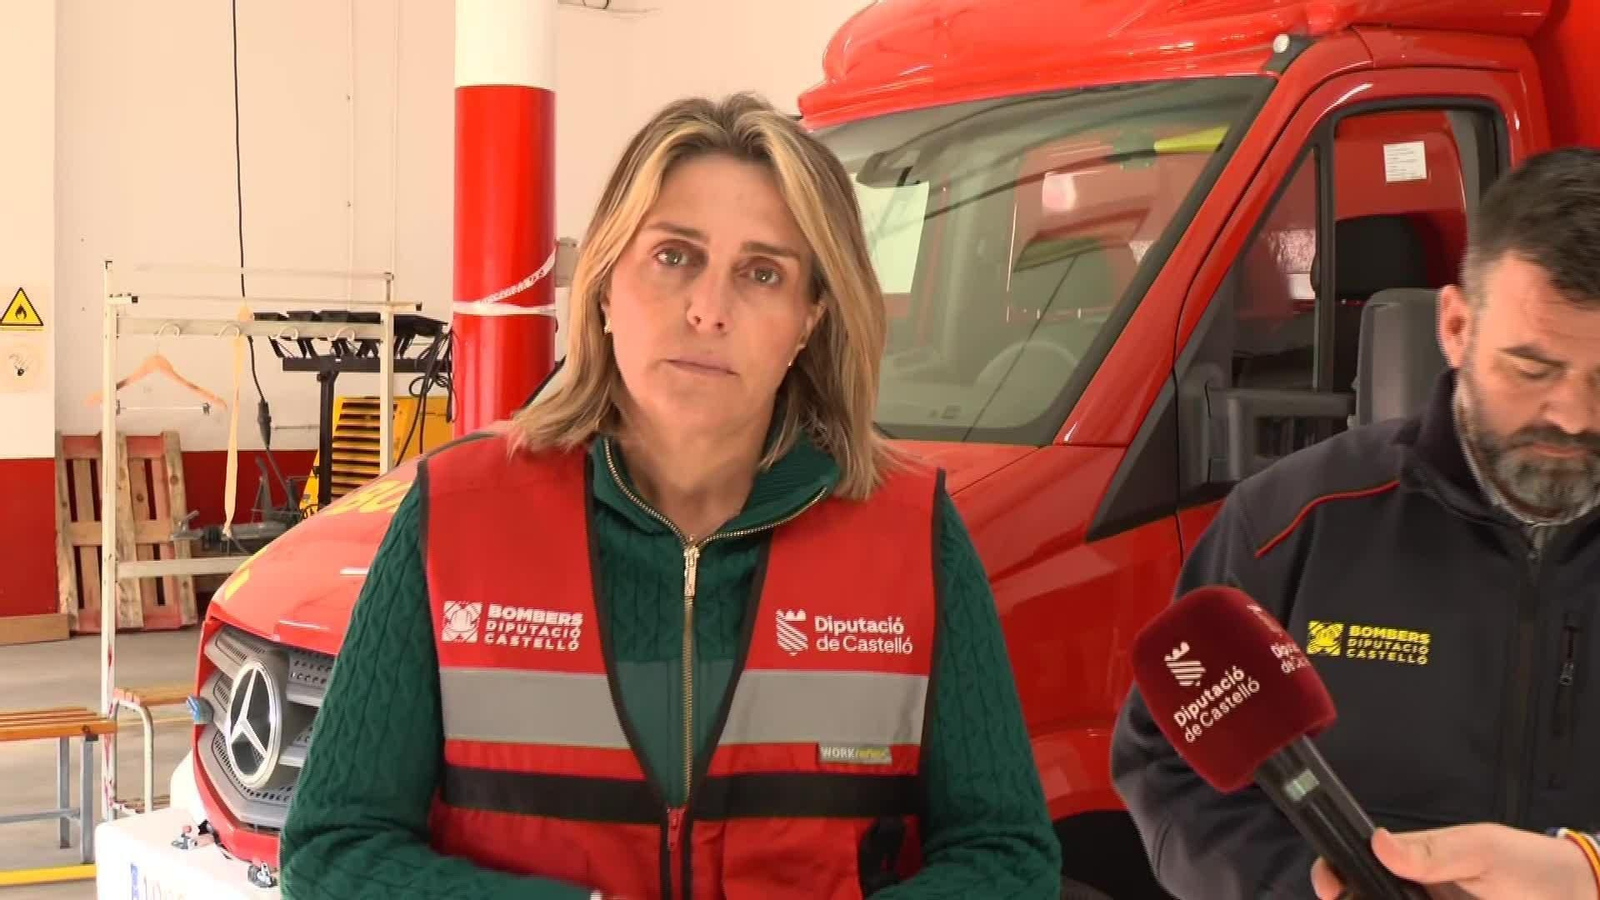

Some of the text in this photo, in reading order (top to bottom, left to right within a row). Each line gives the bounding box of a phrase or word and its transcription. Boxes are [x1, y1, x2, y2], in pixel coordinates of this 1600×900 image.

[487, 604, 583, 626] BOMBERS
[814, 615, 904, 636] Diputació
[816, 635, 913, 655] de Castelló
[1349, 625, 1430, 644] BOMBERS
[1173, 665, 1245, 728] Diputació
[1184, 676, 1260, 744] de Castelló
